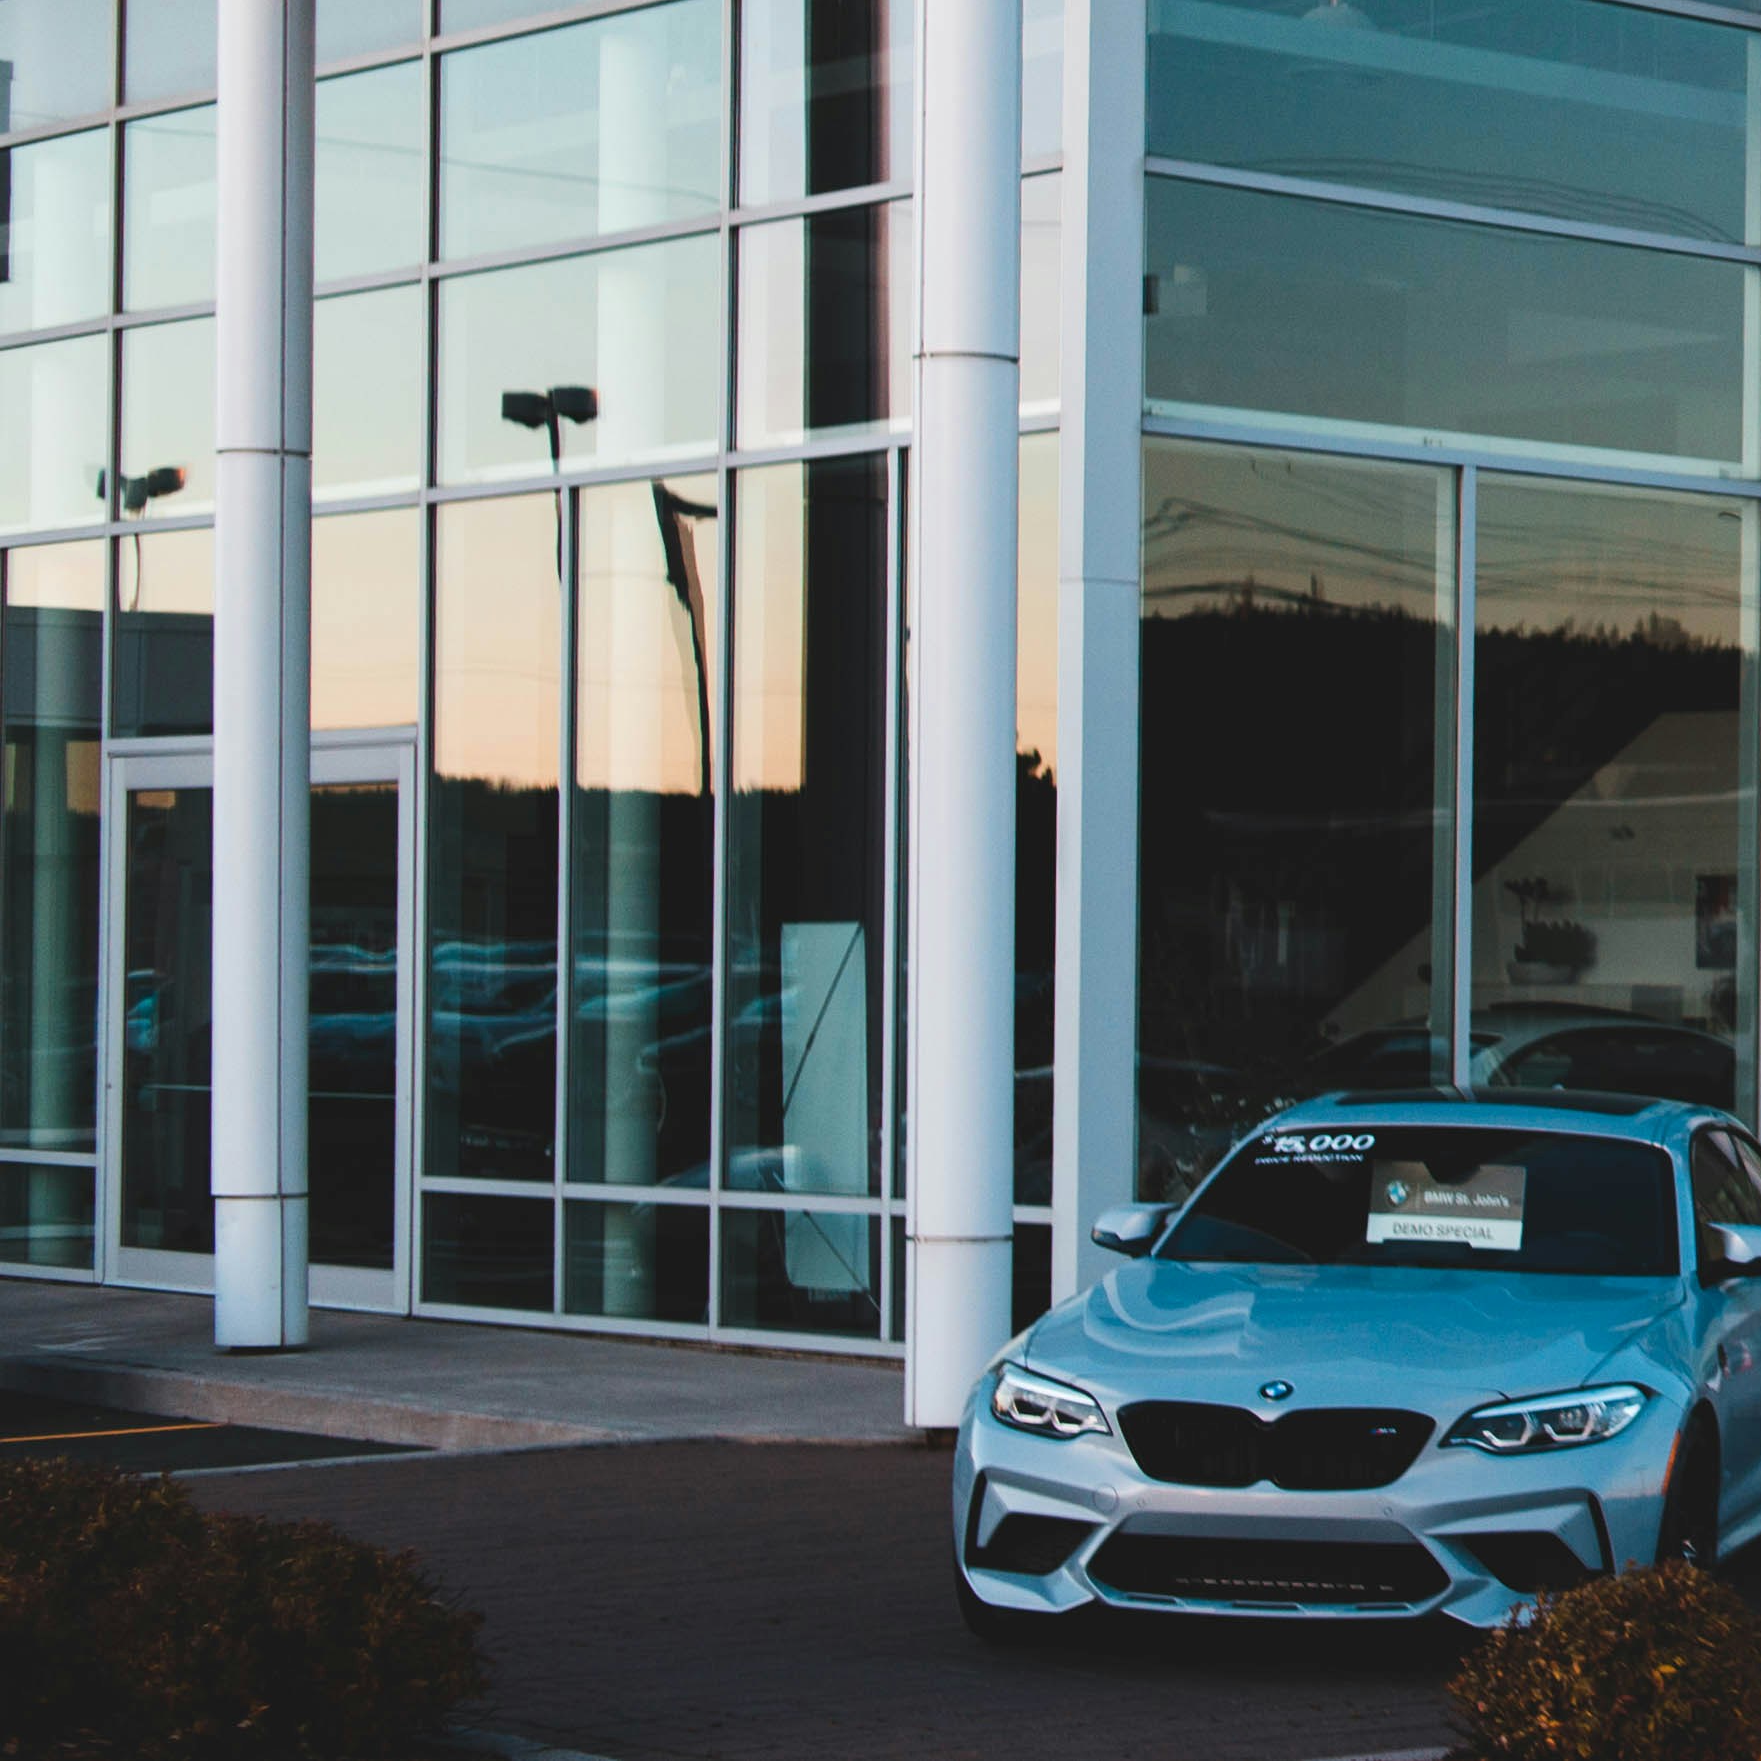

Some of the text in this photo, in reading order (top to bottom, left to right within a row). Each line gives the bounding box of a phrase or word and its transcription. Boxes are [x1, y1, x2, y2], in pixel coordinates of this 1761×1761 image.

[1423, 1190, 1454, 1205] BMW
[1455, 1192, 1471, 1207] St.
[1392, 1220, 1496, 1240] DEMO SPECIAL
